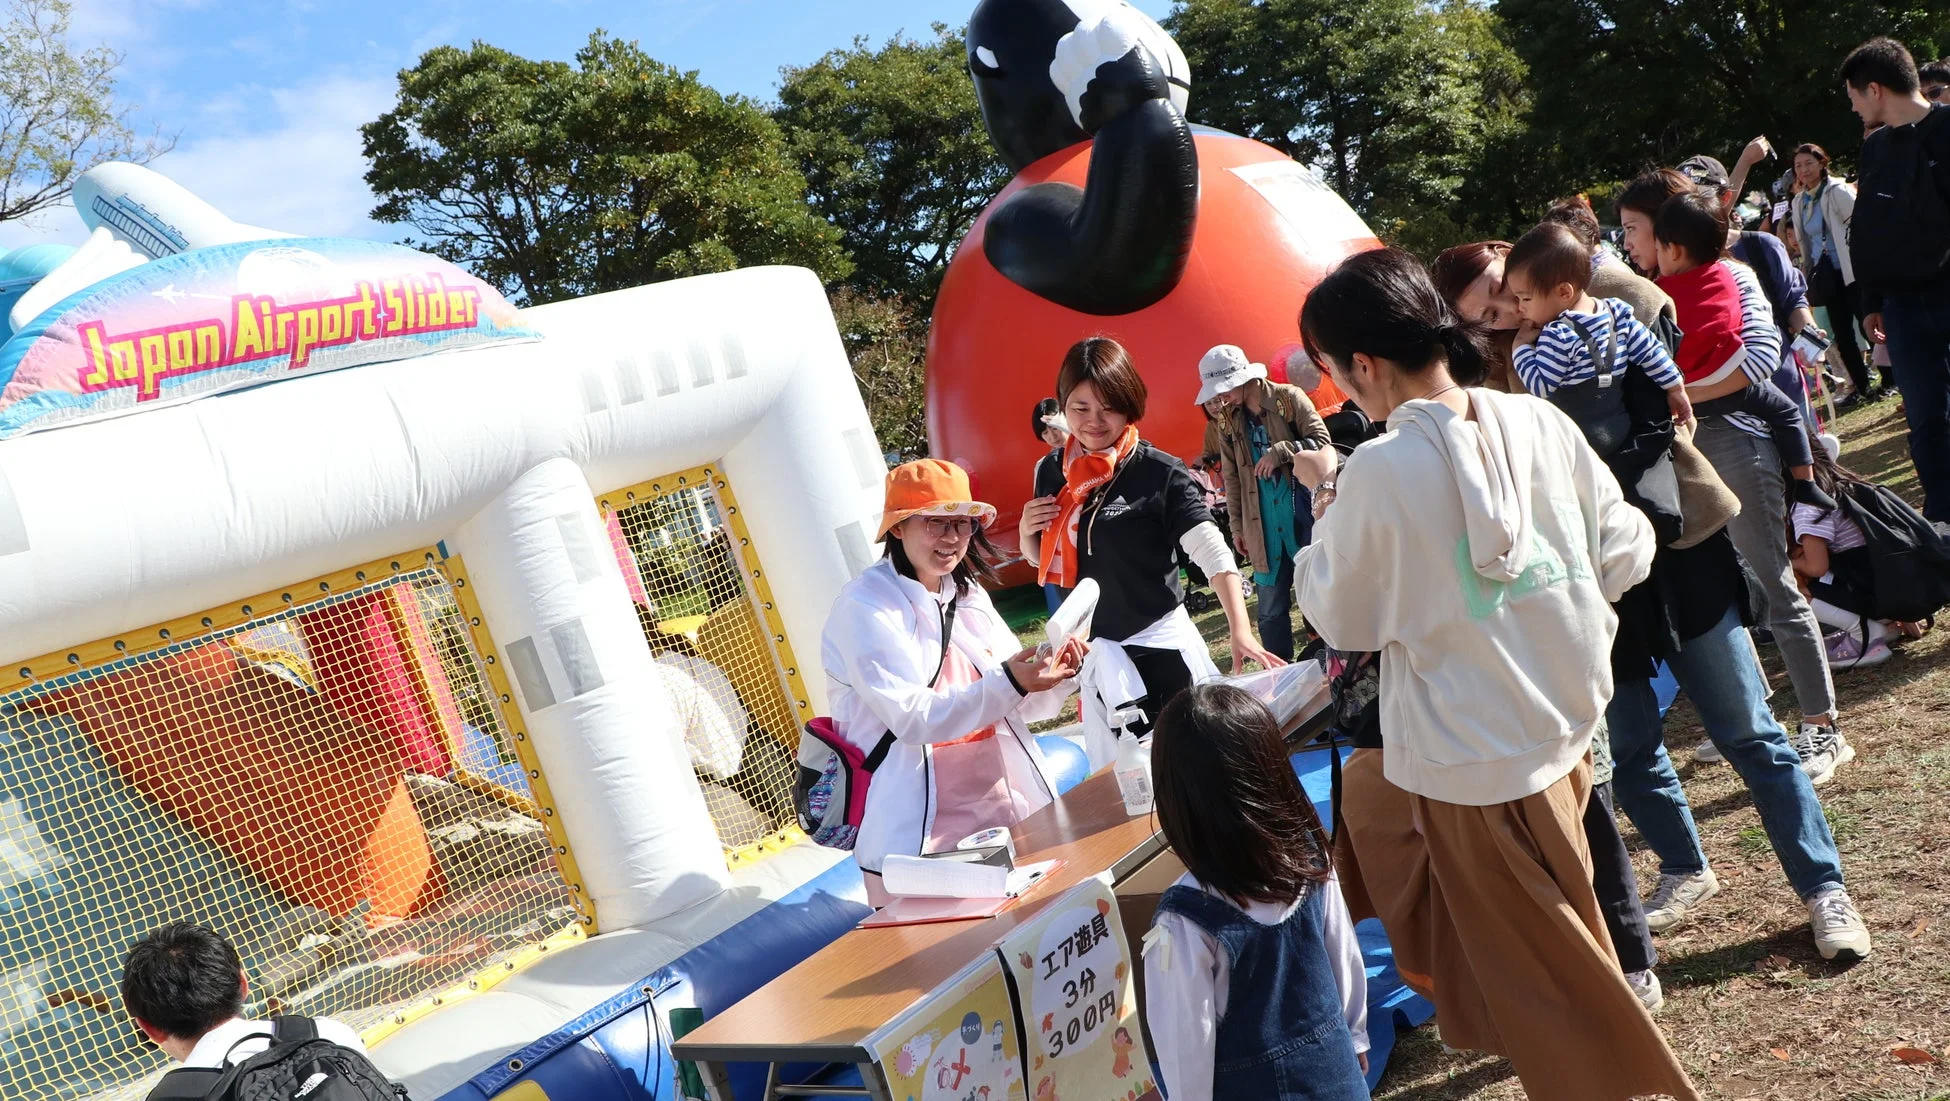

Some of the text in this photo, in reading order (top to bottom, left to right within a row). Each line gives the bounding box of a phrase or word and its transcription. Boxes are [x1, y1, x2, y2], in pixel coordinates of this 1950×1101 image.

[82, 274, 480, 398] Japan Airport Slider
[1041, 912, 1110, 981] エア遊具
[1062, 966, 1097, 1009] 3分
[1048, 989, 1116, 1059] 300円
